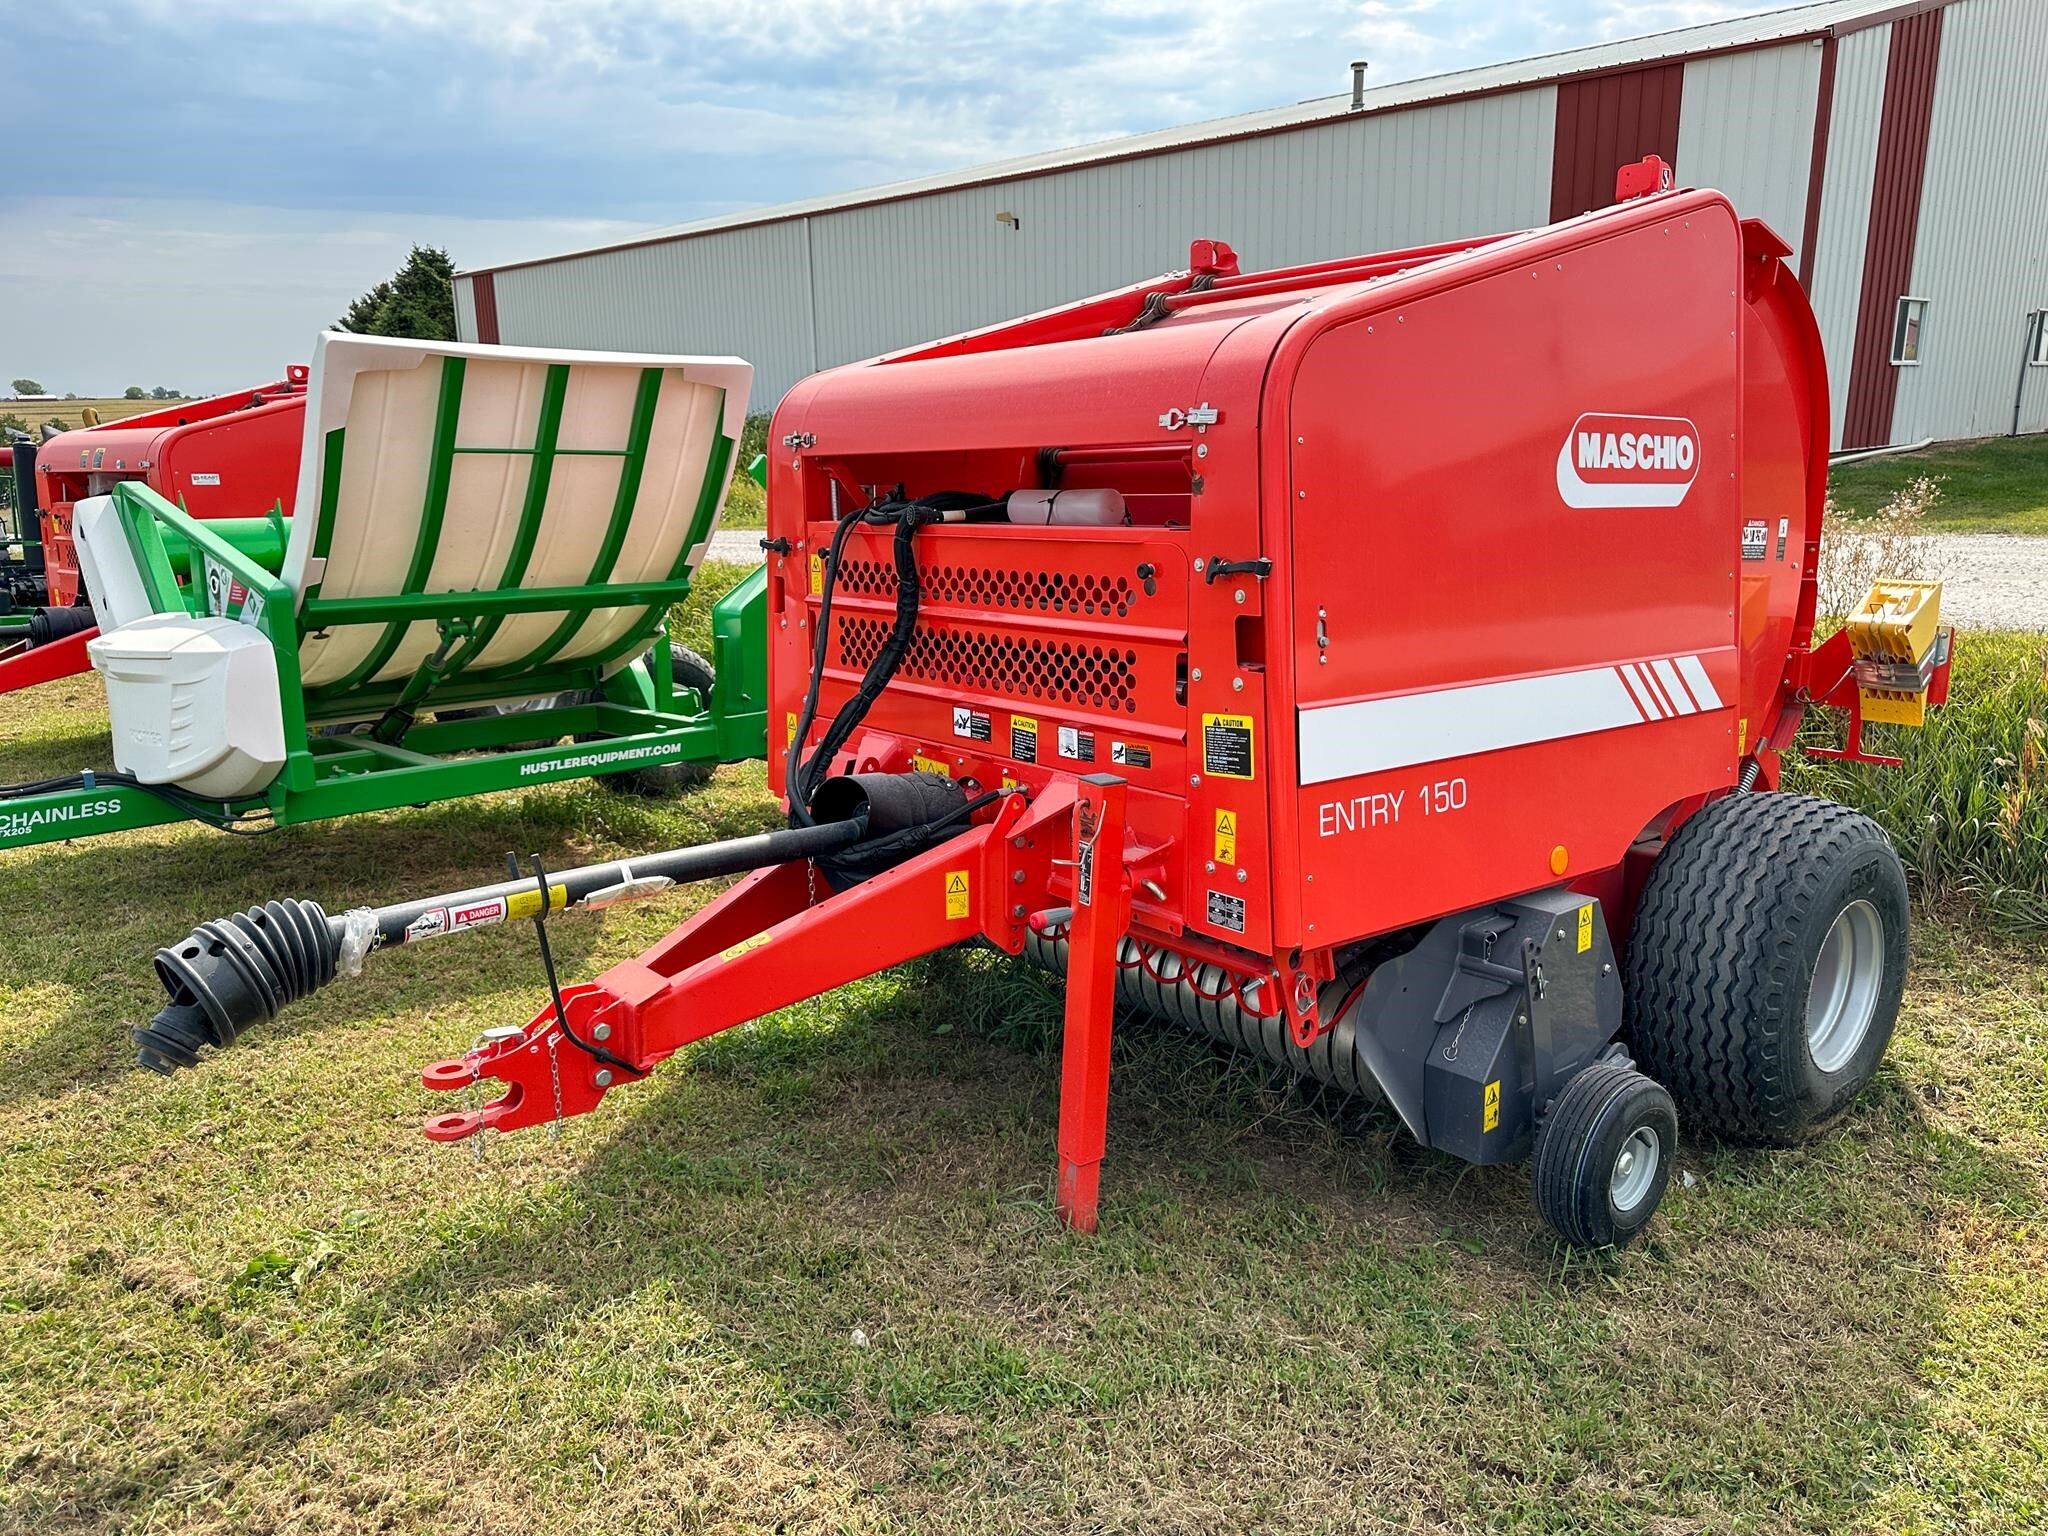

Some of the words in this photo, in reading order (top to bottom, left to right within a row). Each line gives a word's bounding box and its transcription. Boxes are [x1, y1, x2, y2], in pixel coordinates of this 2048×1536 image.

[1578, 431, 1694, 470] MASCHIO
[1017, 719, 1036, 730] CAUTION
[1223, 719, 1243, 727] CAUTION
[520, 743, 682, 776] HUSTLEREQUIPMENT.COM
[0, 799, 121, 831] CHAINLESS
[1319, 789, 1405, 838] ENTRY
[1418, 777, 1467, 816] 150
[469, 904, 500, 921] DANGER
